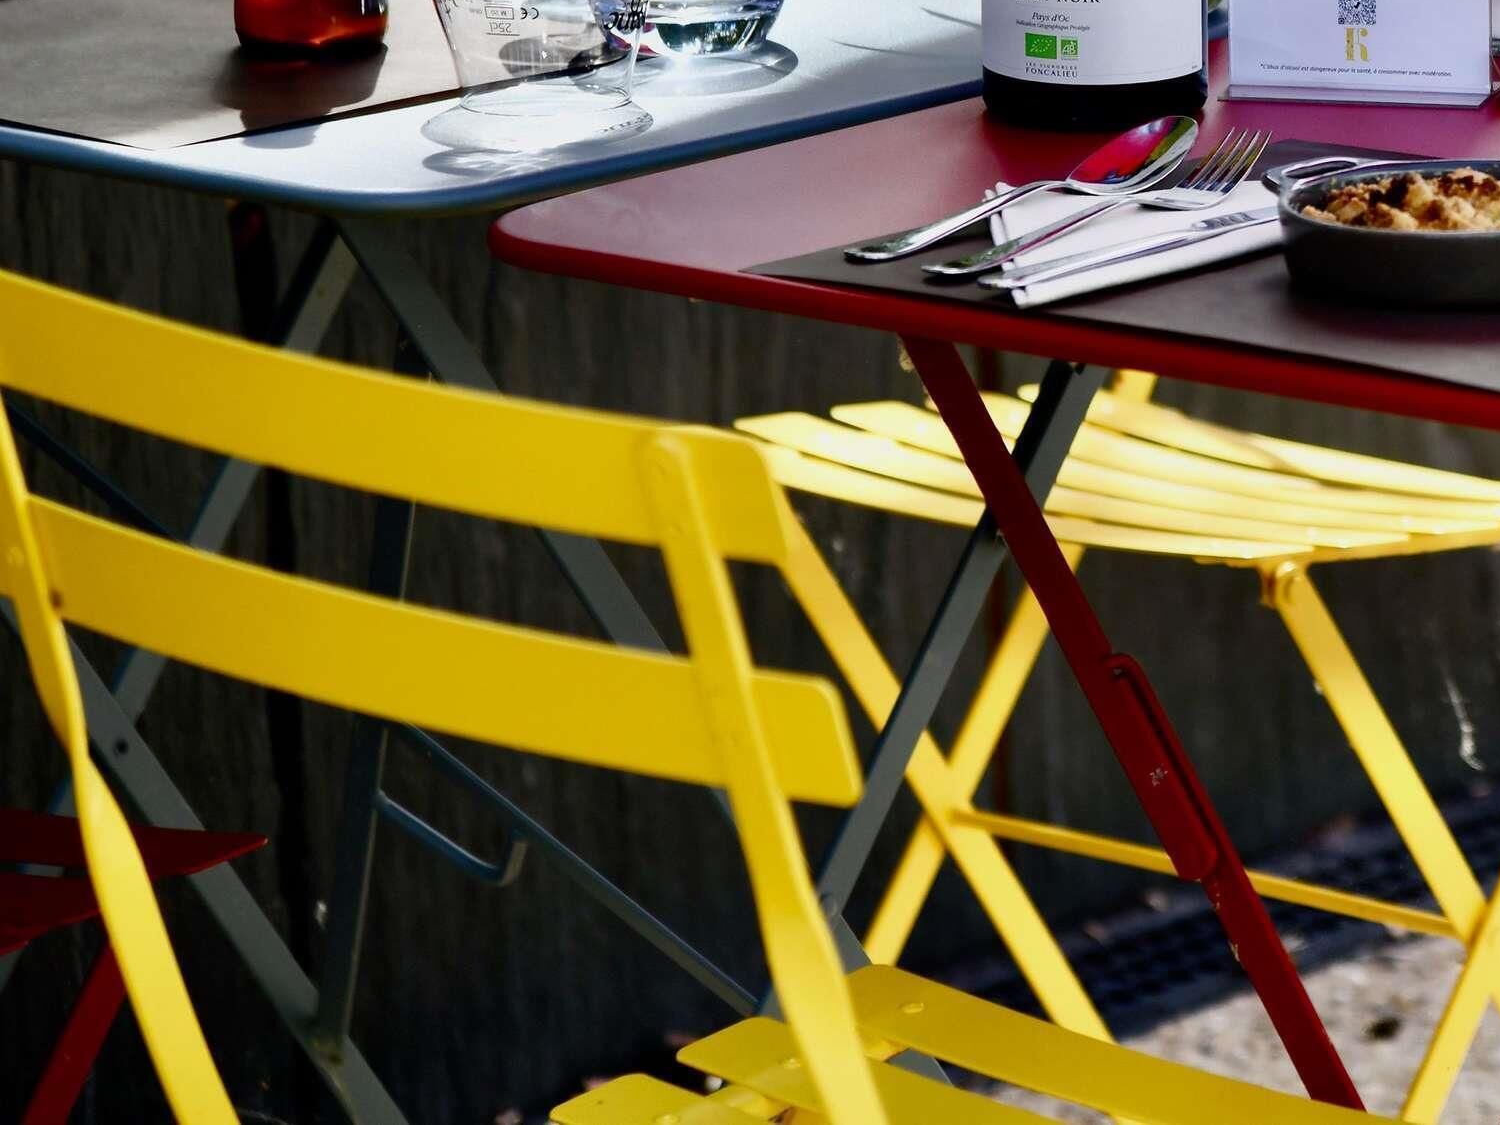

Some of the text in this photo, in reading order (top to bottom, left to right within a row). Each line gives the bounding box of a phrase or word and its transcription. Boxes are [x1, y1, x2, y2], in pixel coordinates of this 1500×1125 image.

[1032, 11, 1070, 23] Pays d'Oc
[488, 22, 512, 33] 25cl
[1025, 67, 1078, 78] FONCALIEU
